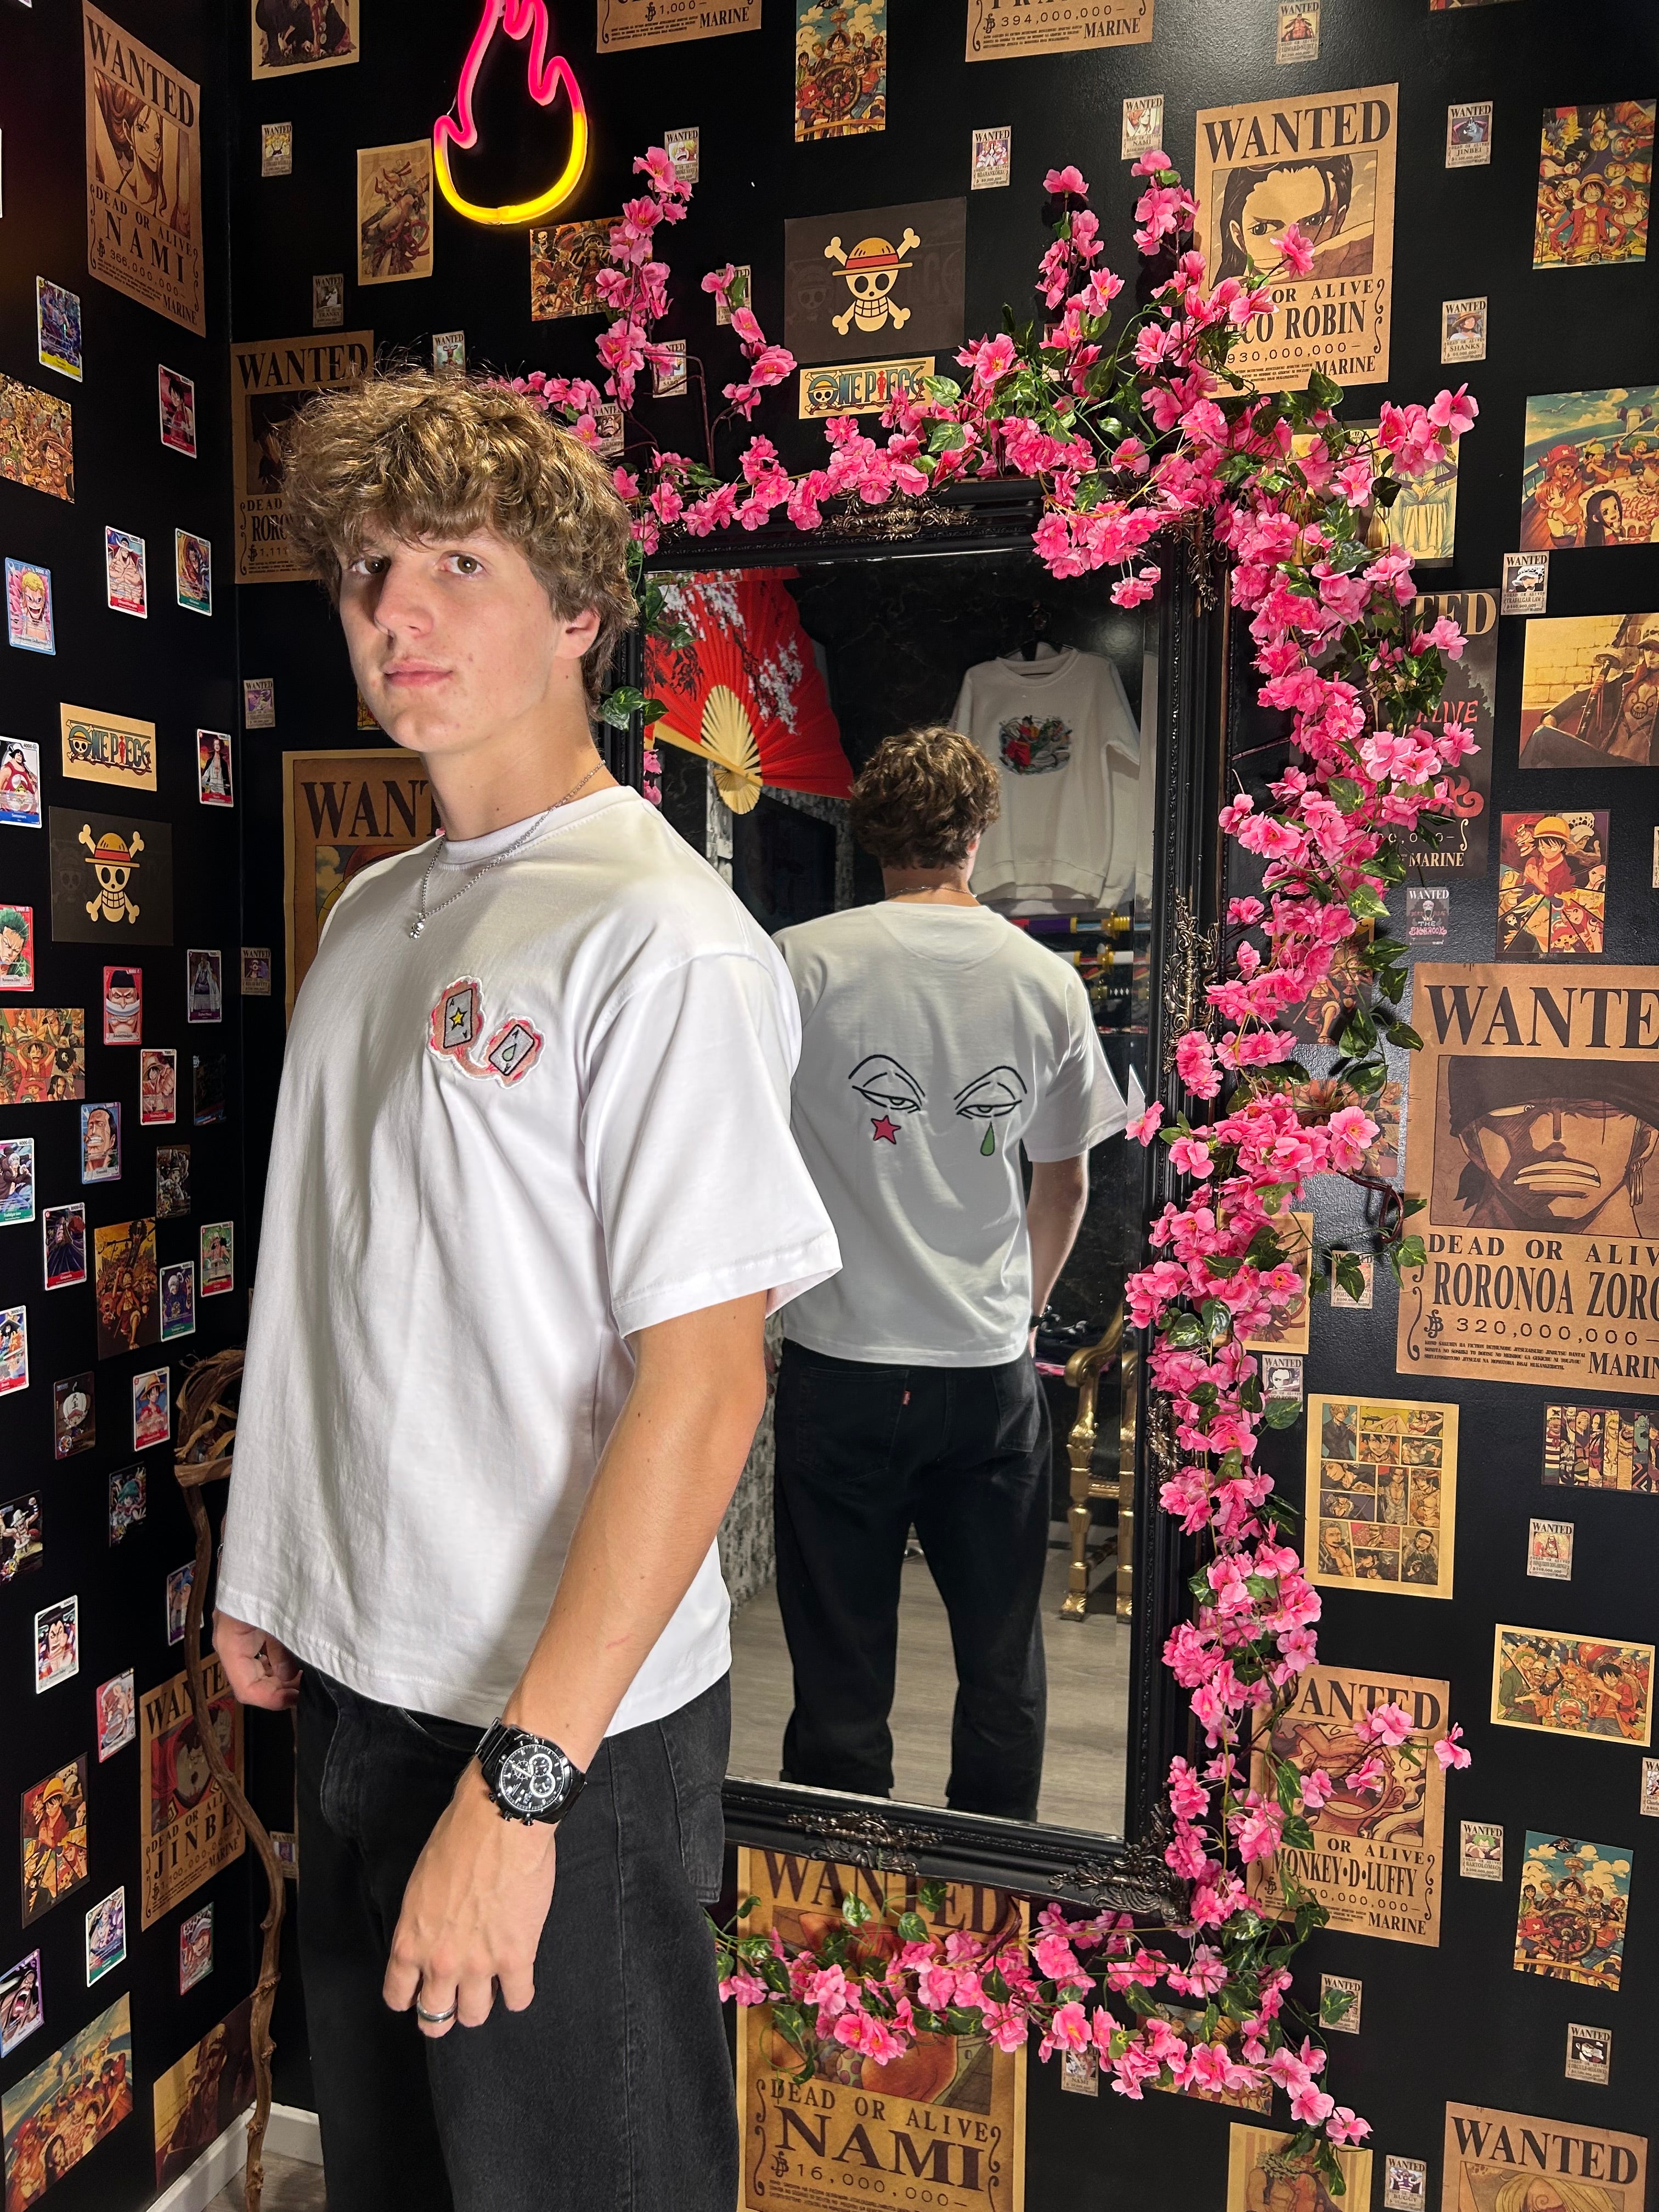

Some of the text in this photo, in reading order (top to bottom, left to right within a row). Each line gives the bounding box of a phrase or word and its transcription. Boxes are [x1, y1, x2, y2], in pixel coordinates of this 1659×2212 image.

[1281, 2, 1319, 15] WANTED
[700, 7, 749, 28] MARINE
[1084, 18, 1140, 38] MARINE
[86, 15, 194, 128] WANTED
[1126, 98, 1162, 110] WANTED
[1451, 105, 1491, 117] WANTED
[264, 125, 291, 136] WANTED
[667, 130, 698, 143] WANTED
[975, 130, 1009, 142] WANTED
[1202, 99, 1391, 163] WANTED
[1457, 147, 1482, 157] JINBEI
[95, 185, 193, 258] DEAD OR ALIVE
[106, 208, 185, 285] NAMI
[315, 277, 342, 286] WANTED
[1272, 279, 1374, 304] OR ALIVE
[163, 294, 198, 326] MARINE
[1446, 301, 1486, 313] WANTED
[1284, 300, 1367, 341] ROBIN
[435, 334, 464, 345] WANTED
[1449, 343, 1480, 352] SHANKS
[235, 343, 369, 390] WANTED
[1315, 355, 1376, 377] MARINE
[246, 498, 283, 512] DEAD
[1506, 555, 1547, 566] WANTED
[246, 680, 273, 690] WANTED
[1408, 851, 1465, 868] MARINE
[1409, 889, 1449, 899] WANTED
[243, 950, 270, 958] WANTED
[449, 998, 454, 1007] A
[1424, 985, 1659, 1049] WANTE
[512, 1029, 520, 1039] A
[1427, 1233, 1659, 1267] DEAD OR ALIV
[1432, 1261, 1574, 1314] RORONOA
[1265, 1358, 1301, 1368] WANTED
[1532, 1522, 1572, 1534] WANTED
[151, 1810, 199, 1854] DEAD OR
[1464, 1824, 1502, 1837] WANTED
[1327, 1838, 1425, 1865] OR ALIVE
[1466, 1861, 1499, 1870] BARTOLOMEO
[1368, 1912, 1426, 1936] MARINE
[1324, 1977, 1361, 1991] WANTED
[1571, 2027, 1610, 2041] WANTED
[770, 2078, 989, 2143] DEAD OR ALIVE
[774, 2105, 985, 2192] NAMI
[1451, 2116, 1638, 2185] WANTED
[1389, 2158, 1425, 2172] WANTED
